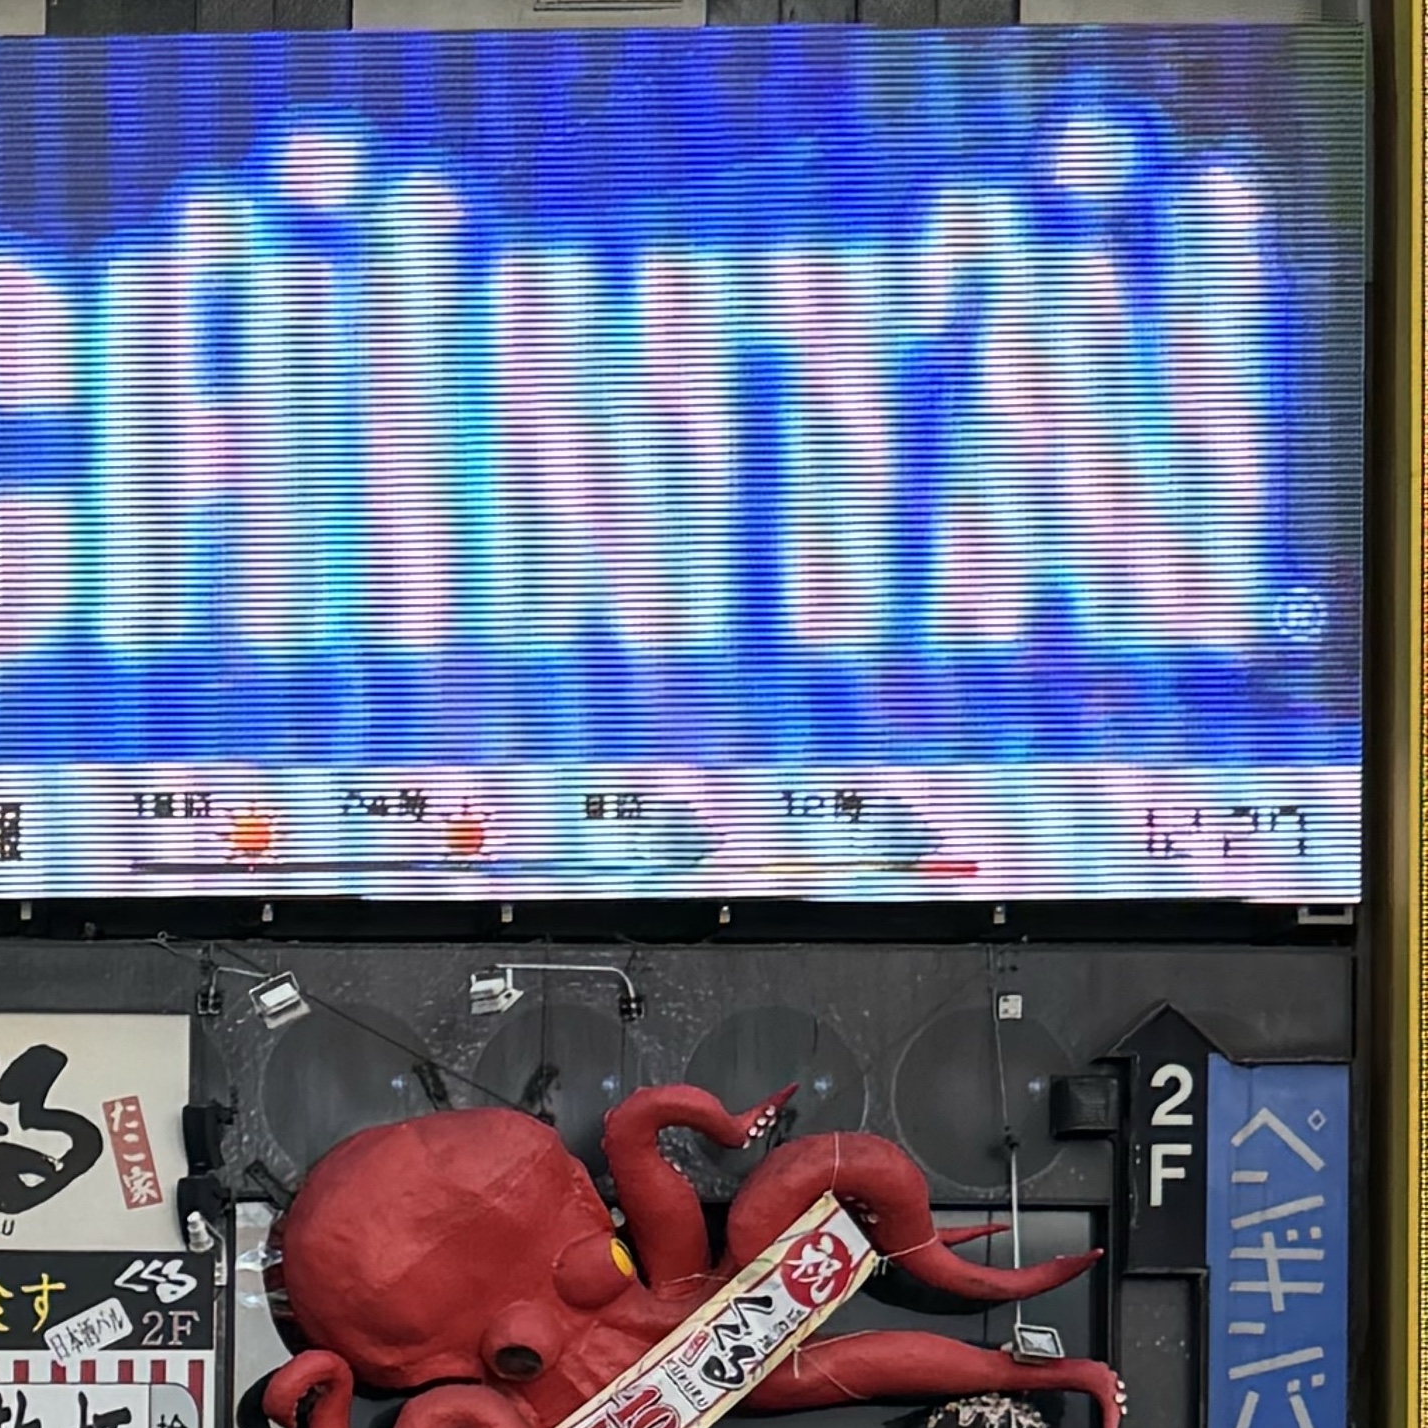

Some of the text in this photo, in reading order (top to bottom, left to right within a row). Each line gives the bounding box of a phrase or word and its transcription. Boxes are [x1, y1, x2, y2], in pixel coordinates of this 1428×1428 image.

[1150, 1064, 1194, 1207] 2F
[114, 1259, 198, 1302] くくる
[785, 1230, 843, 1305] 祝
[141, 1310, 200, 1346] 2F
[700, 1293, 776, 1389] くくる
